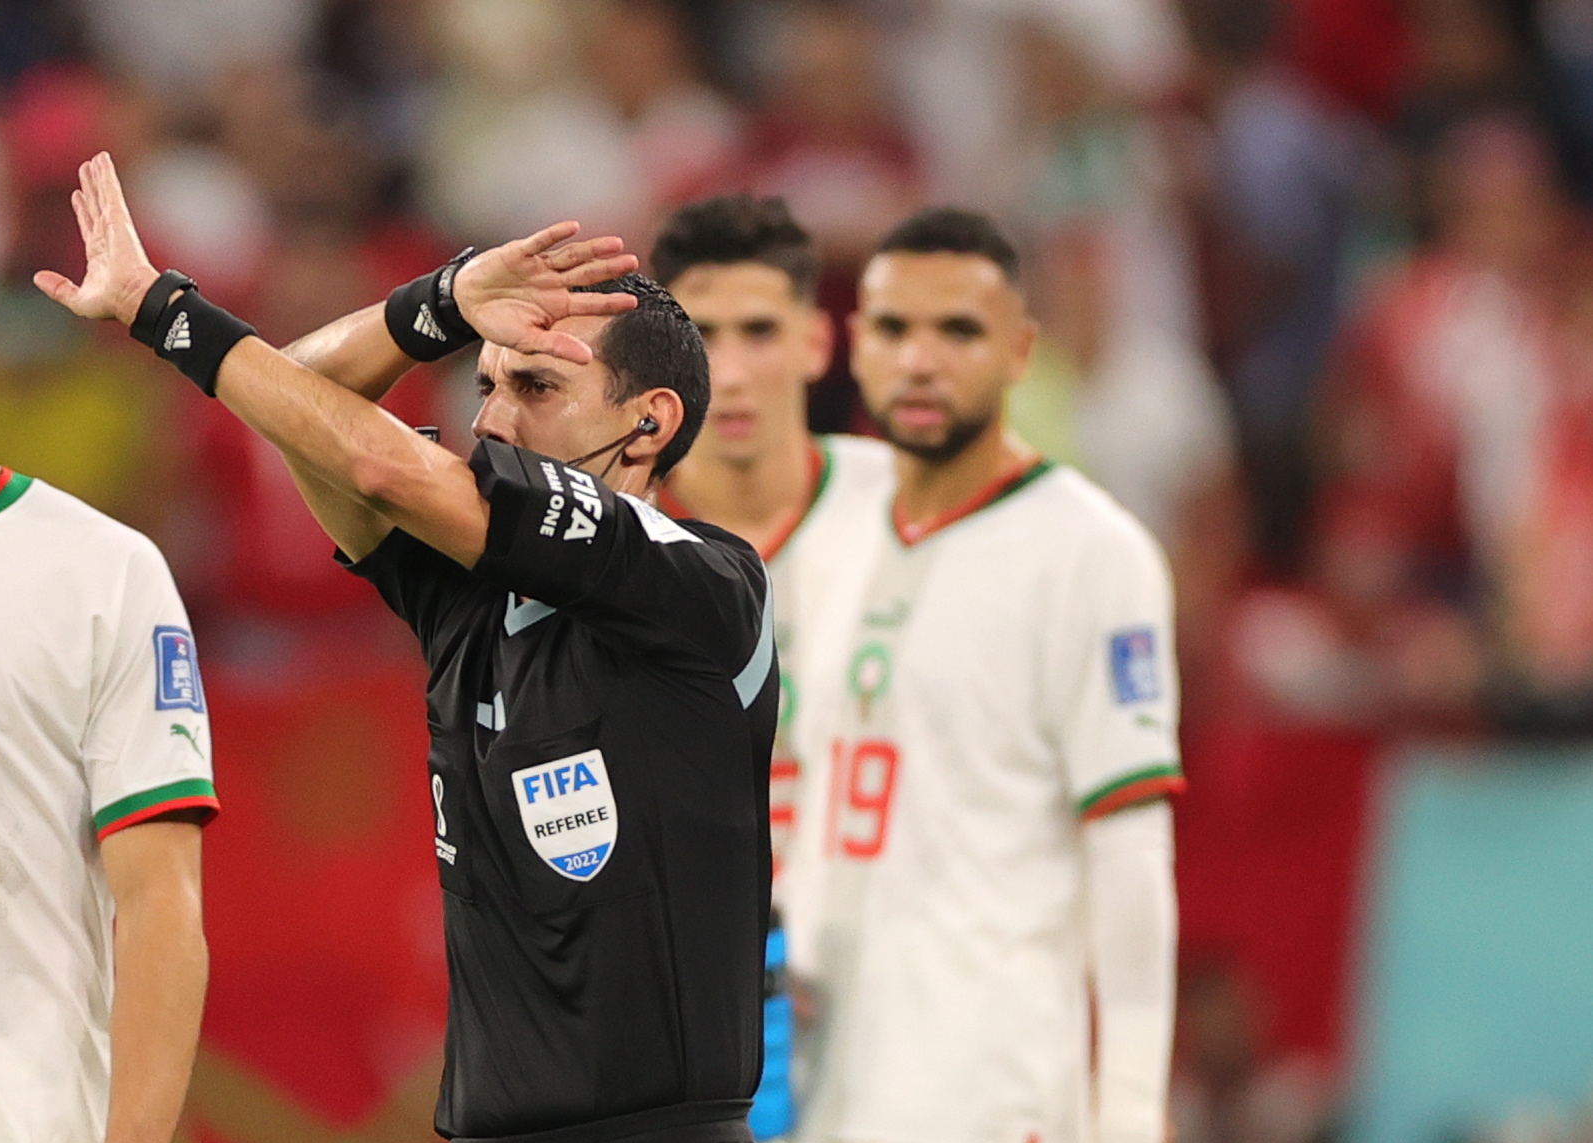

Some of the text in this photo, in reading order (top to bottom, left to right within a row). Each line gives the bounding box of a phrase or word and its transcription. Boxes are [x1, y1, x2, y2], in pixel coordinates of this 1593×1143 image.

[539, 461, 565, 538] TEAM ONE
[563, 466, 603, 541] FIFA
[522, 762, 599, 804] FIFA
[823, 737, 901, 862] 19
[534, 806, 609, 839] REFEREE
[564, 851, 599, 871] 2022
